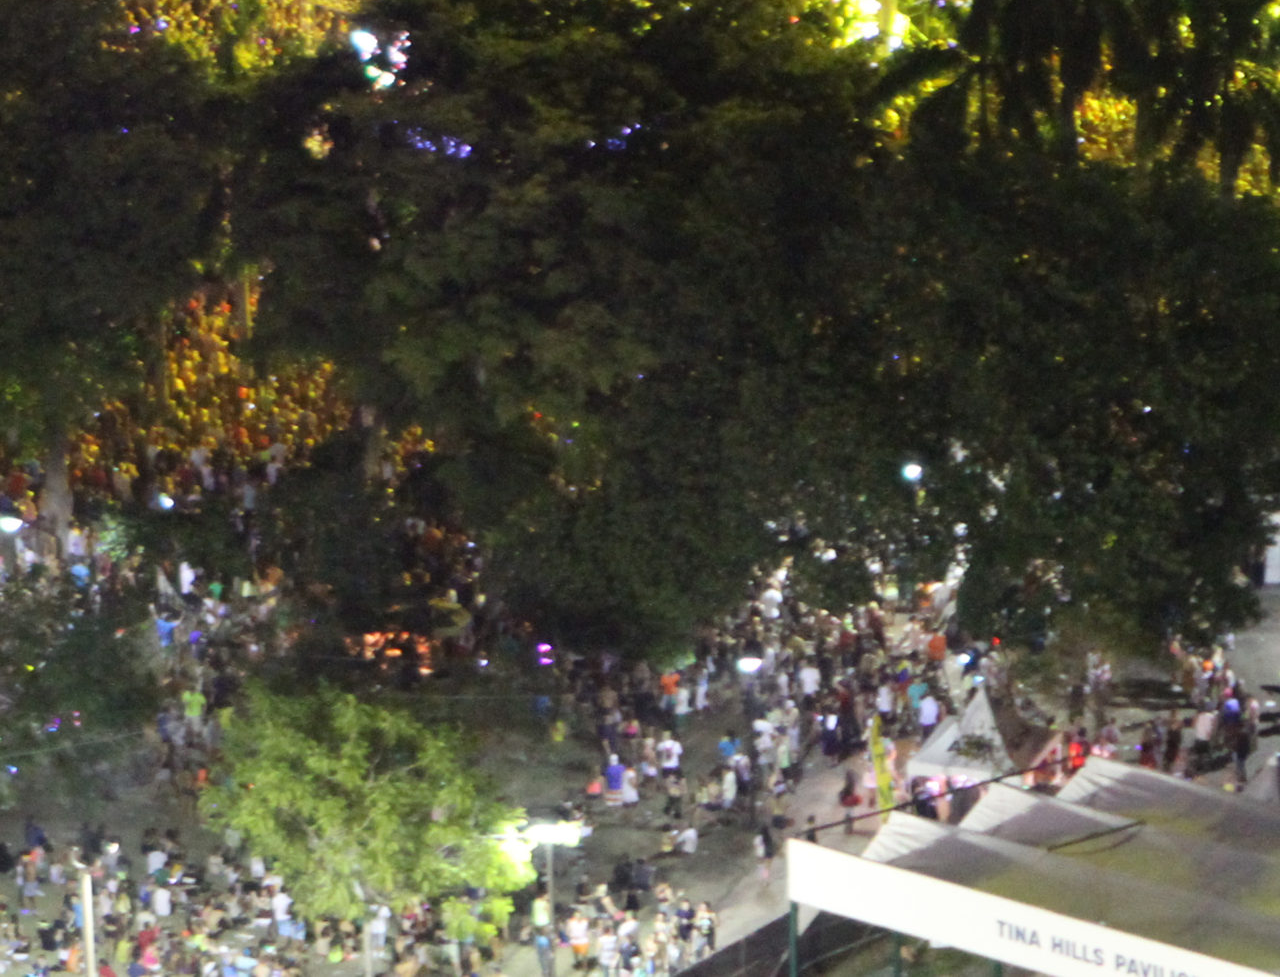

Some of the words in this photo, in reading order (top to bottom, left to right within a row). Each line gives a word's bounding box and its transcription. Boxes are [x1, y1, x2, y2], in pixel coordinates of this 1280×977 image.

[997, 919, 1041, 948] TINA
[1051, 936, 1104, 966] HILLS
[1115, 954, 1199, 977] PAVIL
